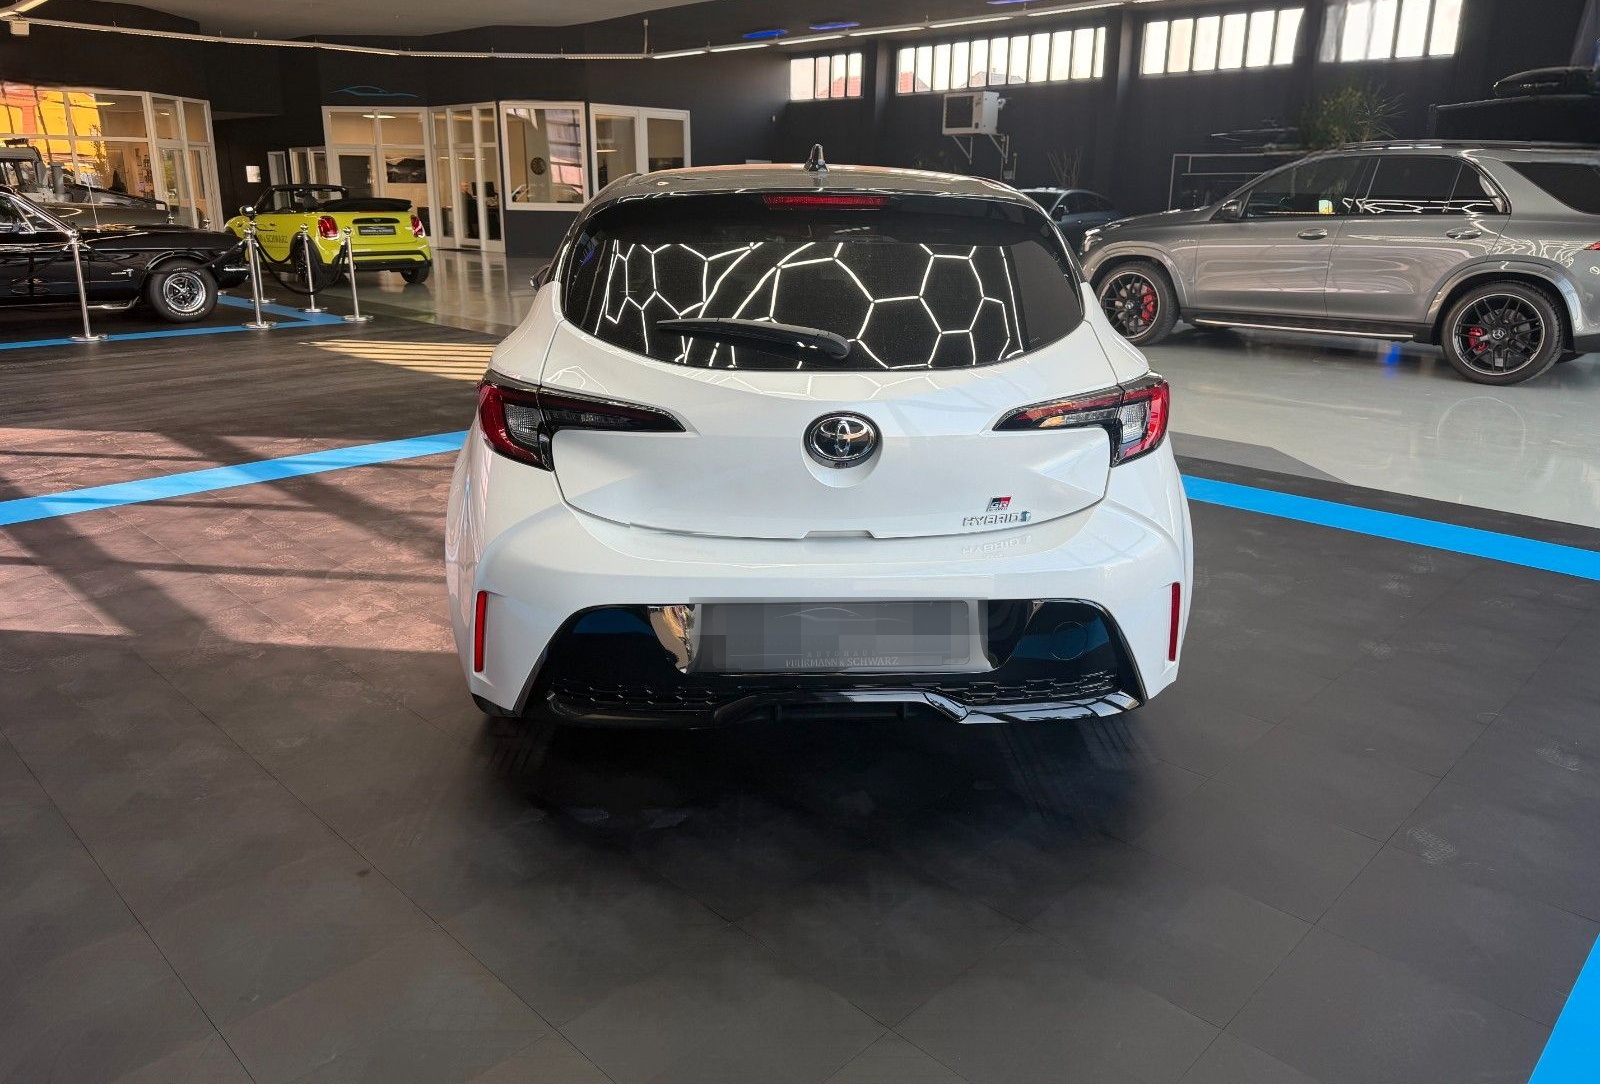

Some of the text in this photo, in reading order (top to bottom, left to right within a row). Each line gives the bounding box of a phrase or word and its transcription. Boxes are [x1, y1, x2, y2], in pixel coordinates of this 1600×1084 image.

[962, 512, 1020, 527] HYBRID
[806, 650, 877, 658] AUTOHAUS
[846, 656, 900, 667] SCHWARZ
